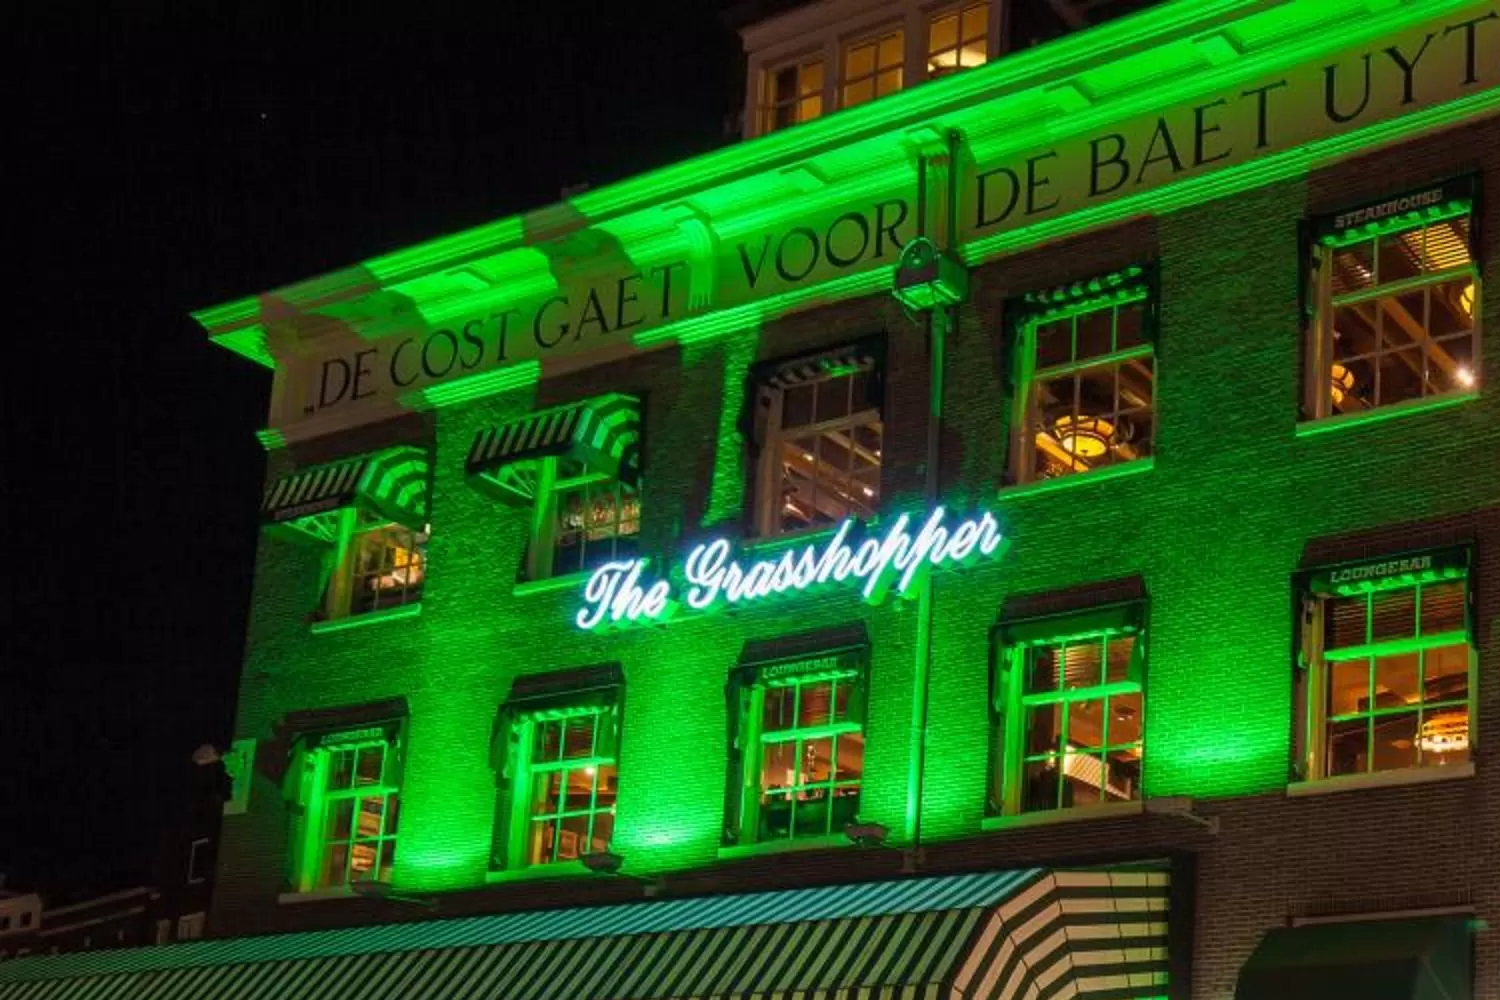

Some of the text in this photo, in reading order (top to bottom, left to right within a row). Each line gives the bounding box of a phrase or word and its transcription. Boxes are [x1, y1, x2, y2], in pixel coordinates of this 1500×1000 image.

[389, 308, 522, 387] COST
[532, 260, 688, 349] GAET
[736, 197, 908, 289] VOOR
[975, 150, 1059, 229] DE
[1087, 79, 1287, 198] BAET
[1335, 189, 1442, 229] STEAKHOUSE
[577, 505, 1002, 629] The Grasshopper
